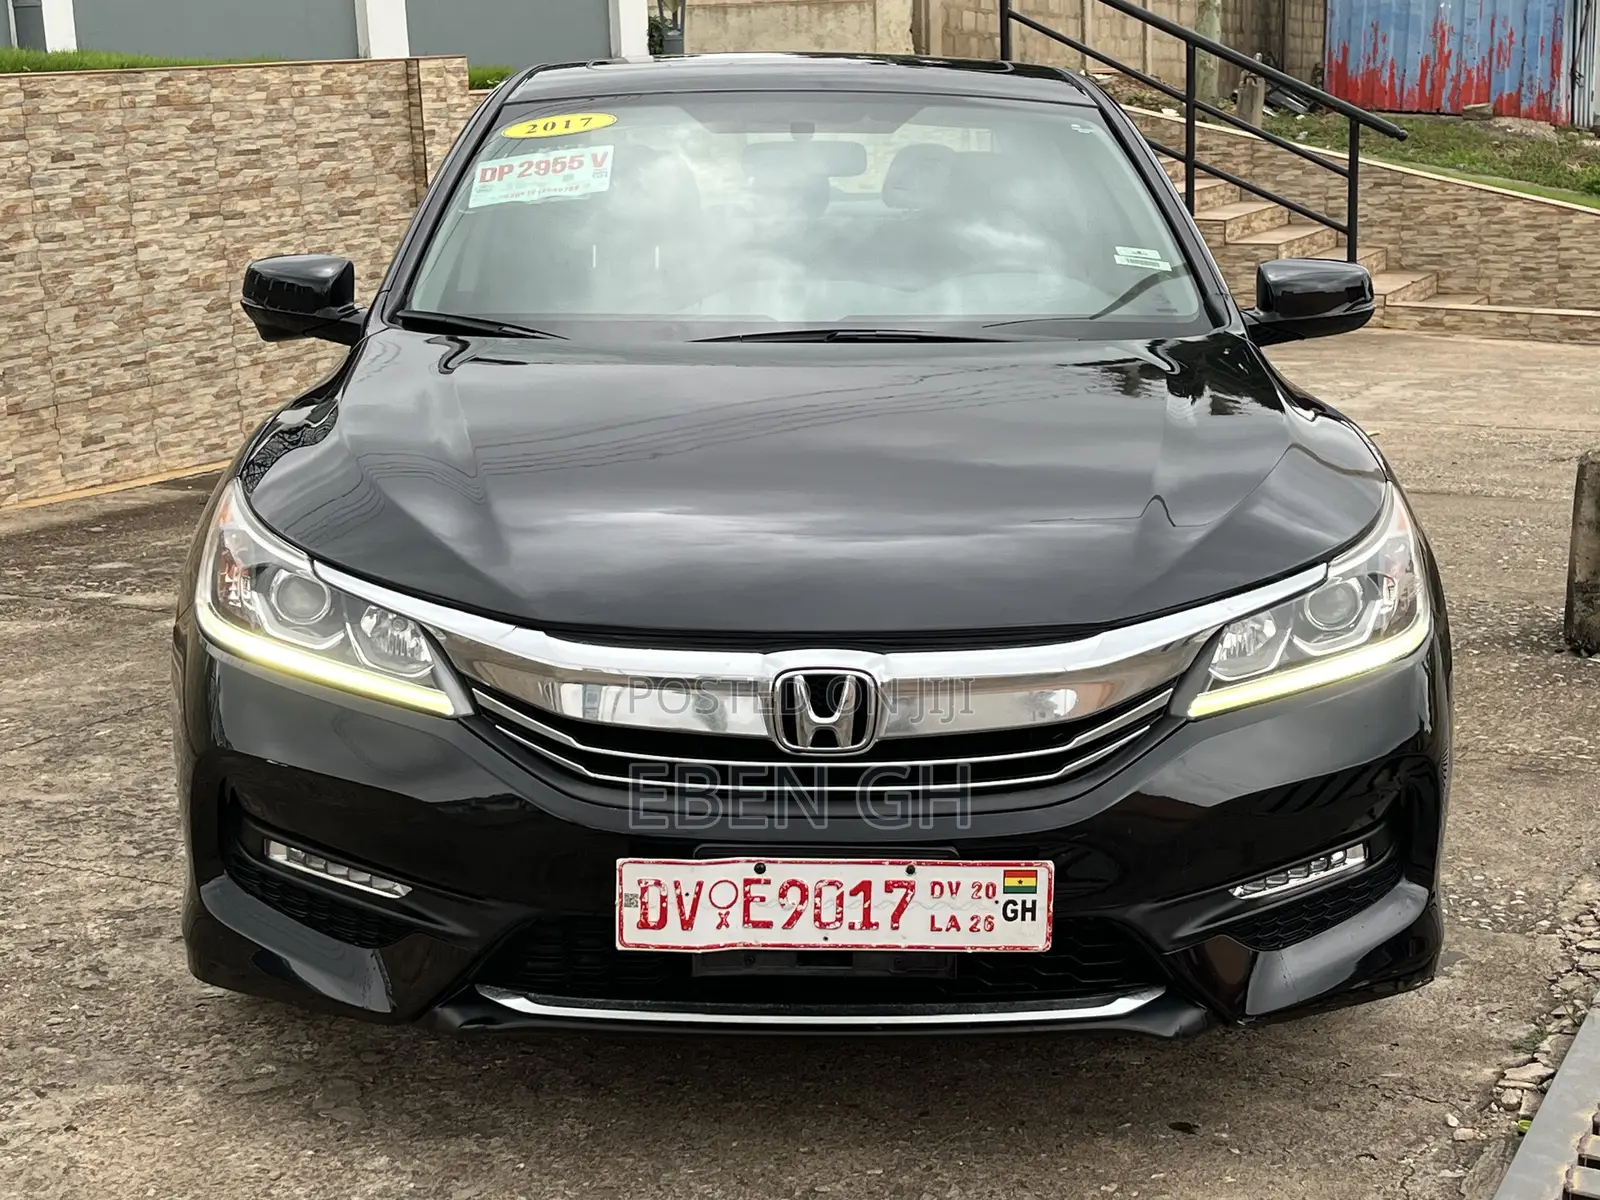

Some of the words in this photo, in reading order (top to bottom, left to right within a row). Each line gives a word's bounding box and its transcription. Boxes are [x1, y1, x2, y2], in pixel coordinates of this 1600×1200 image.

[525, 117, 593, 134] 2017
[479, 163, 514, 183] DP
[517, 154, 585, 179] 2955
[591, 151, 609, 168] V
[930, 880, 961, 899] DV
[971, 881, 997, 900] 20
[637, 878, 704, 931] DV
[742, 877, 916, 931] E9017
[1002, 899, 1037, 922] GH
[930, 914, 961, 932] LA
[969, 914, 995, 932] 26
